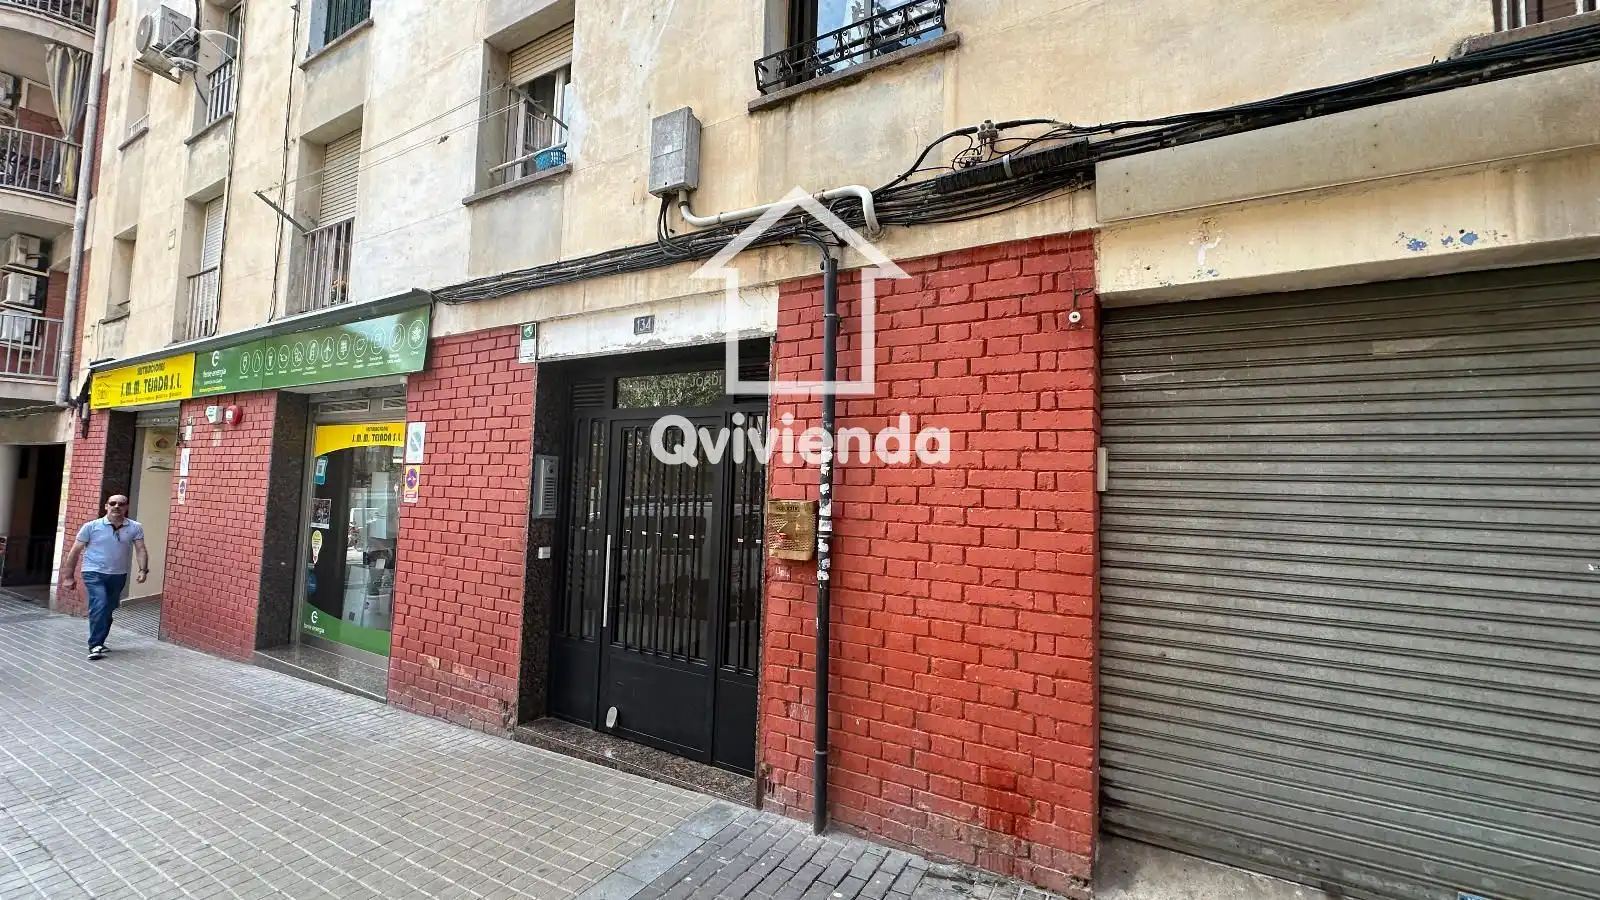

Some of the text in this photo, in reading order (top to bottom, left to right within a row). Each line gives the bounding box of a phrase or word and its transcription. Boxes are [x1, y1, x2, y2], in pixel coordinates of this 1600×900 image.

[636, 318, 652, 332] 134
[144, 376, 168, 393] TEJADA
[660, 376, 686, 389] SANT
[688, 373, 722, 388] JORDI
[371, 433, 392, 442] TEJADA
